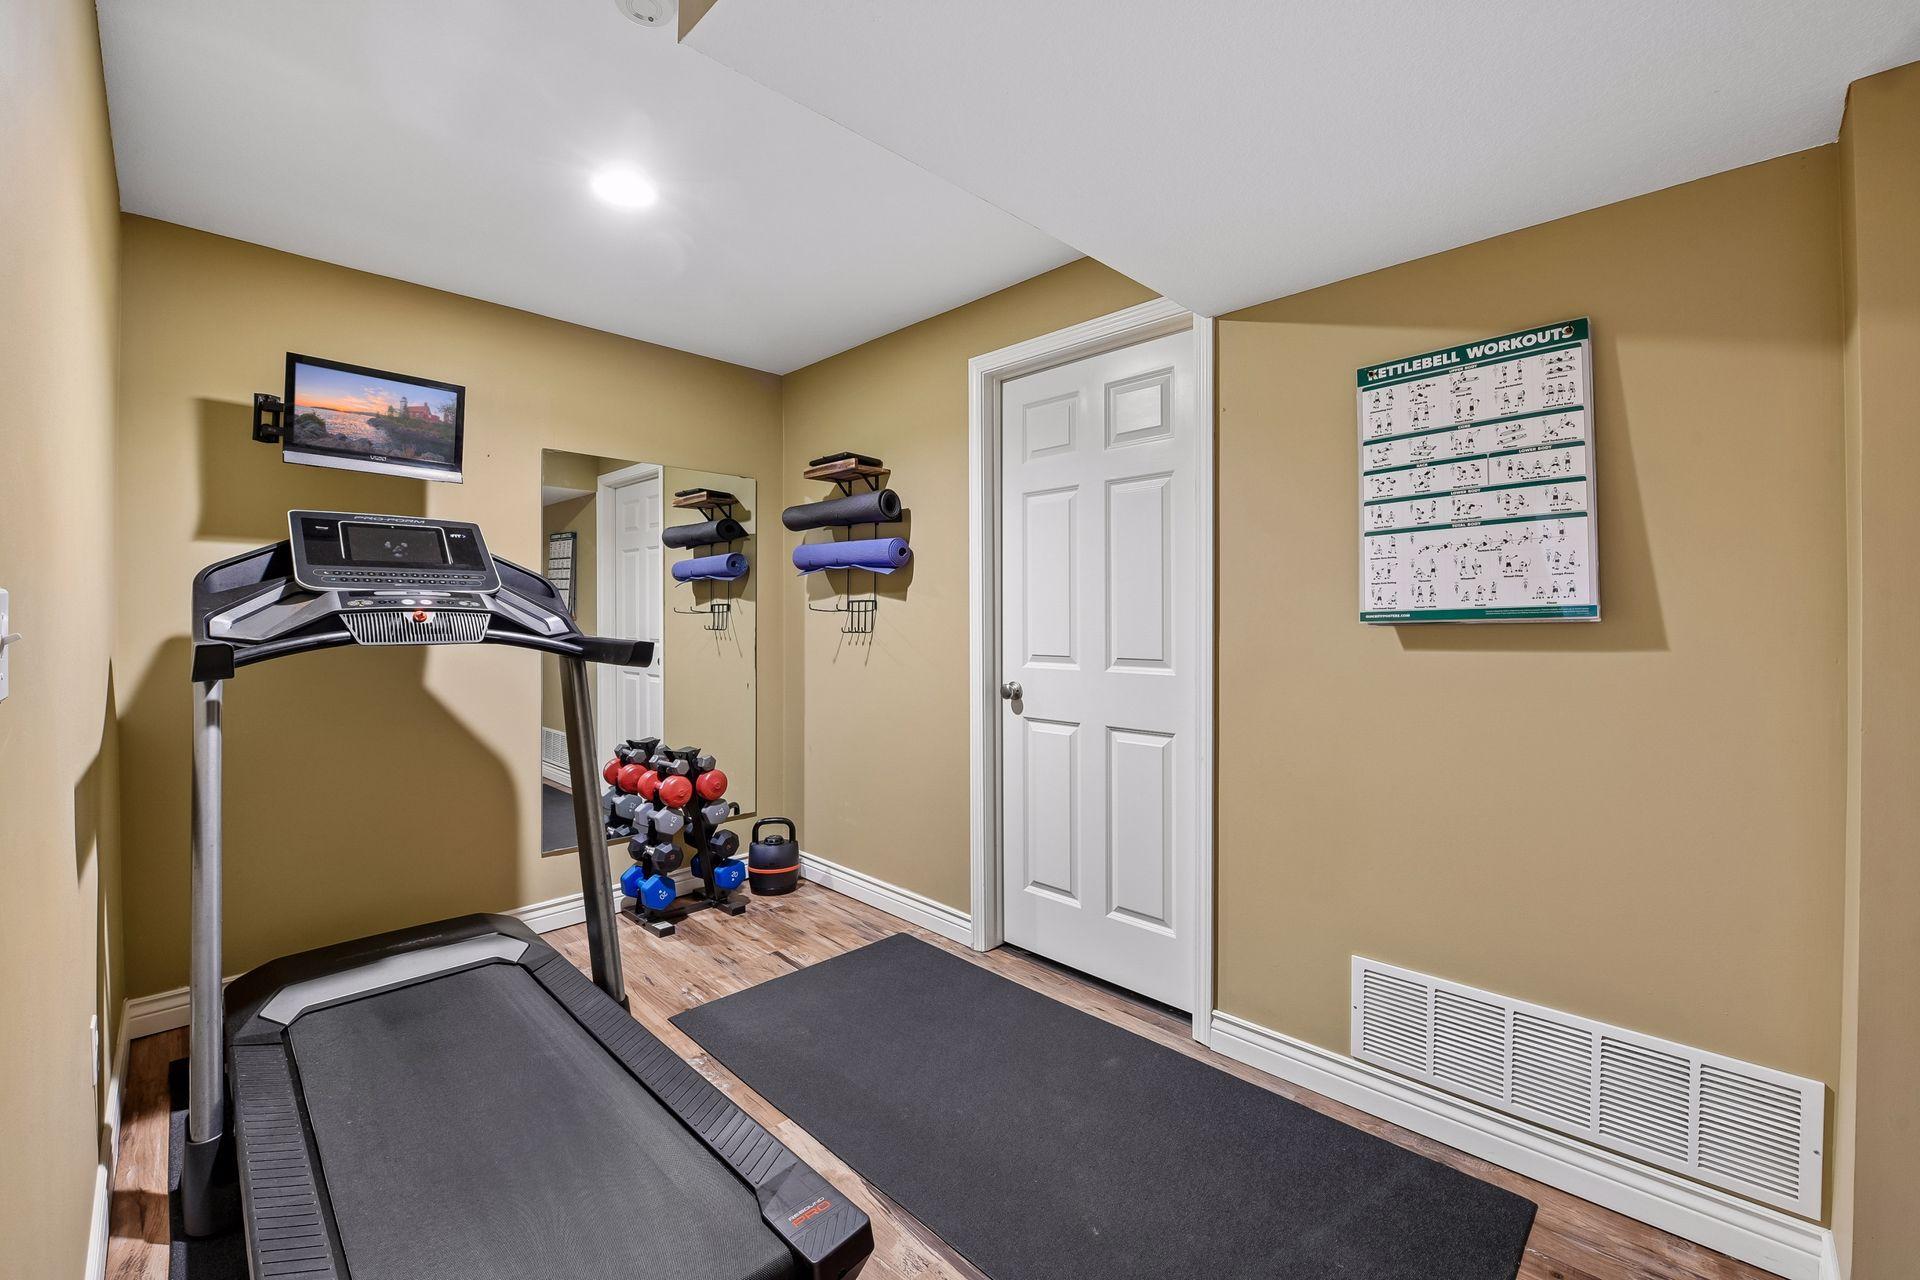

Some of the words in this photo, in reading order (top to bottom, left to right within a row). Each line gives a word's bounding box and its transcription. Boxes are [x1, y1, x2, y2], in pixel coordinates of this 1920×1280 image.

[1367, 351, 1461, 381] KETTLEBELL
[1466, 326, 1574, 359] WORKOUTS
[792, 1200, 833, 1227] PRO
